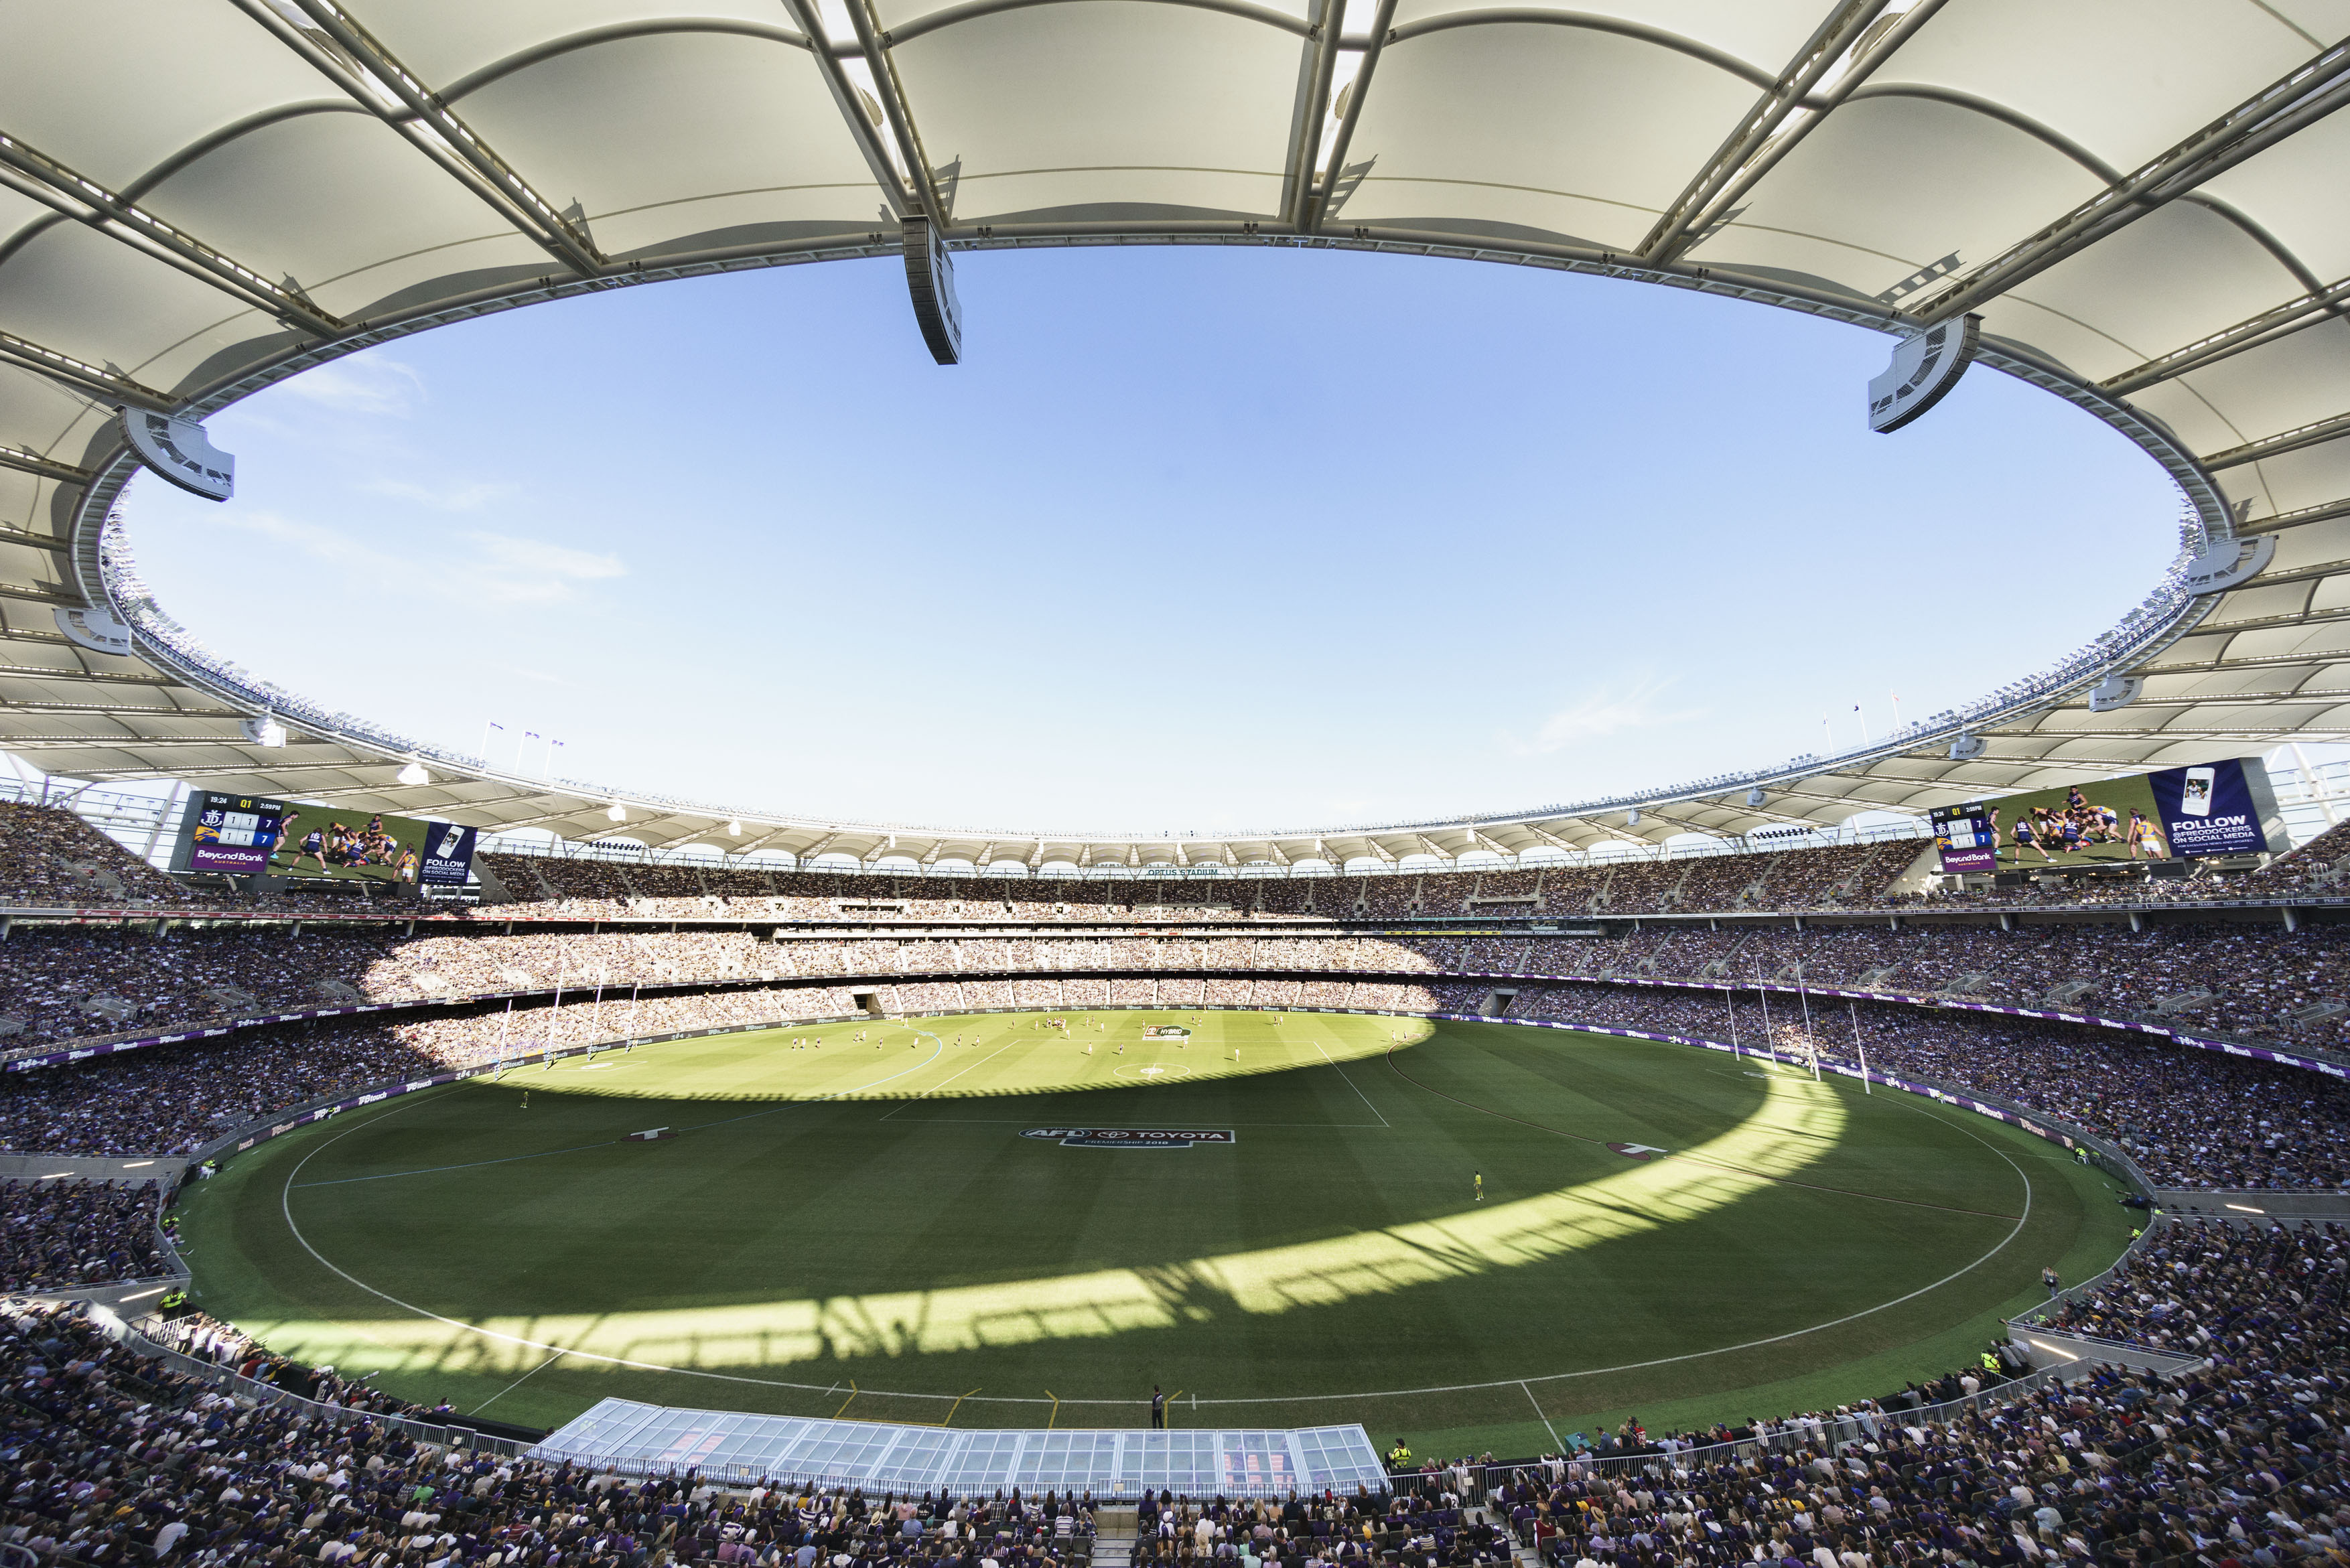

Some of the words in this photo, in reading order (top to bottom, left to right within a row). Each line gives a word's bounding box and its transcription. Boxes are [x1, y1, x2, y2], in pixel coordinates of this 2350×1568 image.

[240, 799, 252, 808] Q1
[232, 816, 236, 824] 1
[266, 820, 272, 828] 7
[1976, 820, 1982, 828] 7
[2172, 815, 2245, 831] FOLLOW
[2140, 825, 2148, 834] 7
[2173, 825, 2252, 839] @FREODOCKERS
[261, 835, 268, 843] 7
[1980, 835, 1985, 843] 7
[2188, 834, 2222, 843] SOCIAL
[2223, 831, 2256, 839] MEDIA
[198, 849, 238, 859] Beyond
[238, 853, 263, 862] Bank
[1945, 854, 1972, 863] Beyond
[1972, 853, 1991, 861] Bank
[426, 859, 466, 868] FOLLOW
[317, 1009, 340, 1017] TABtouch
[2057, 1013, 2085, 1023] TABtouch
[204, 1028, 227, 1037] TABtouch
[2140, 1024, 2170, 1036] TABtouch
[160, 1035, 185, 1044] TABtouch
[113, 1042, 138, 1052] TABtouch
[1705, 1041, 1730, 1052] TABtouch
[2221, 1044, 2252, 1057] TABtouch
[68, 1050, 94, 1059] TABtouch
[406, 1080, 432, 1092] TABtouch
[358, 1091, 387, 1105] TABtouch
[1973, 1102, 2004, 1120] TABtouch
[271, 1121, 295, 1137] TABtouch
[2019, 1118, 2046, 1137] TABtouch
[238, 1138, 254, 1151] touch
[1452, 1498, 1456, 1508] 2
